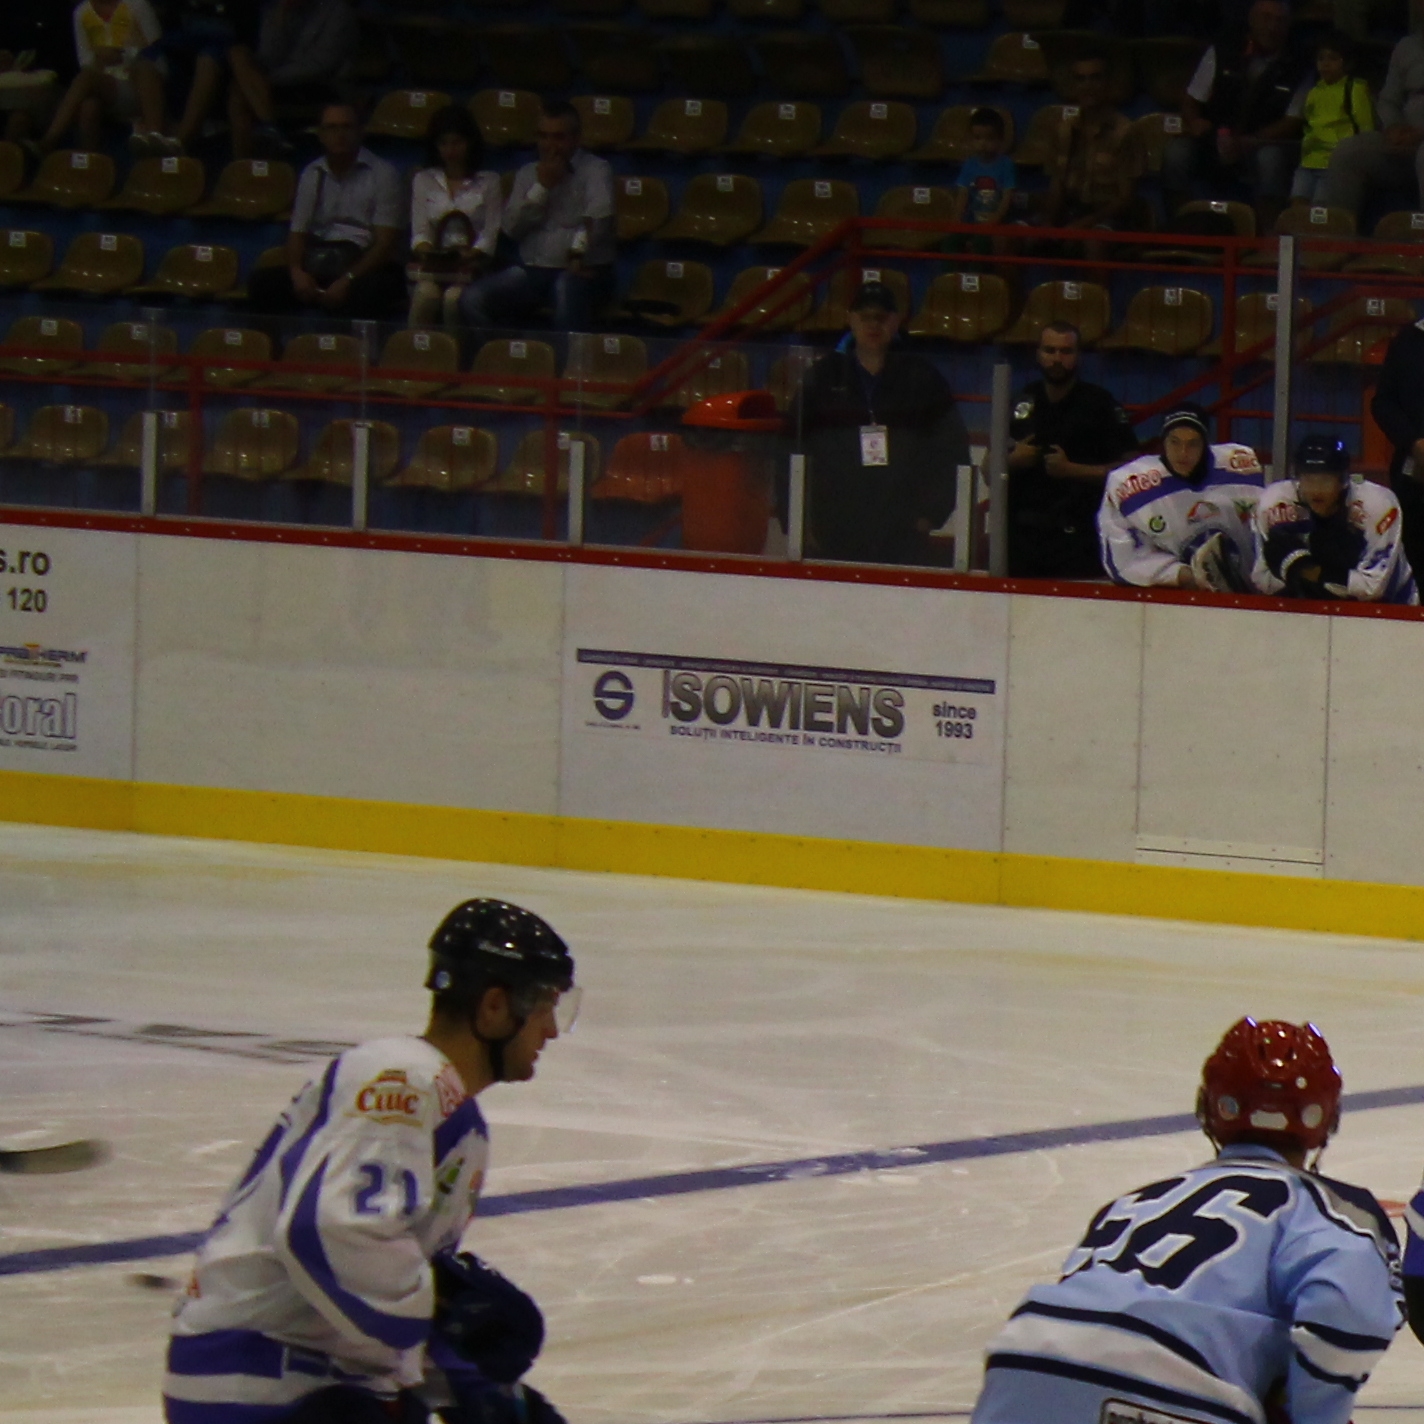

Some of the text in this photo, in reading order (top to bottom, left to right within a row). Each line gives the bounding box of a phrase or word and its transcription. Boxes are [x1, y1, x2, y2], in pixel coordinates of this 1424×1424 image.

[6, 586, 48, 613] 120
[669, 672, 905, 738] SOWIENS
[932, 701, 976, 720] since
[720, 729, 800, 745] INTELIGENTE
[934, 720, 974, 739] 1993
[356, 1164, 418, 1215] 21
